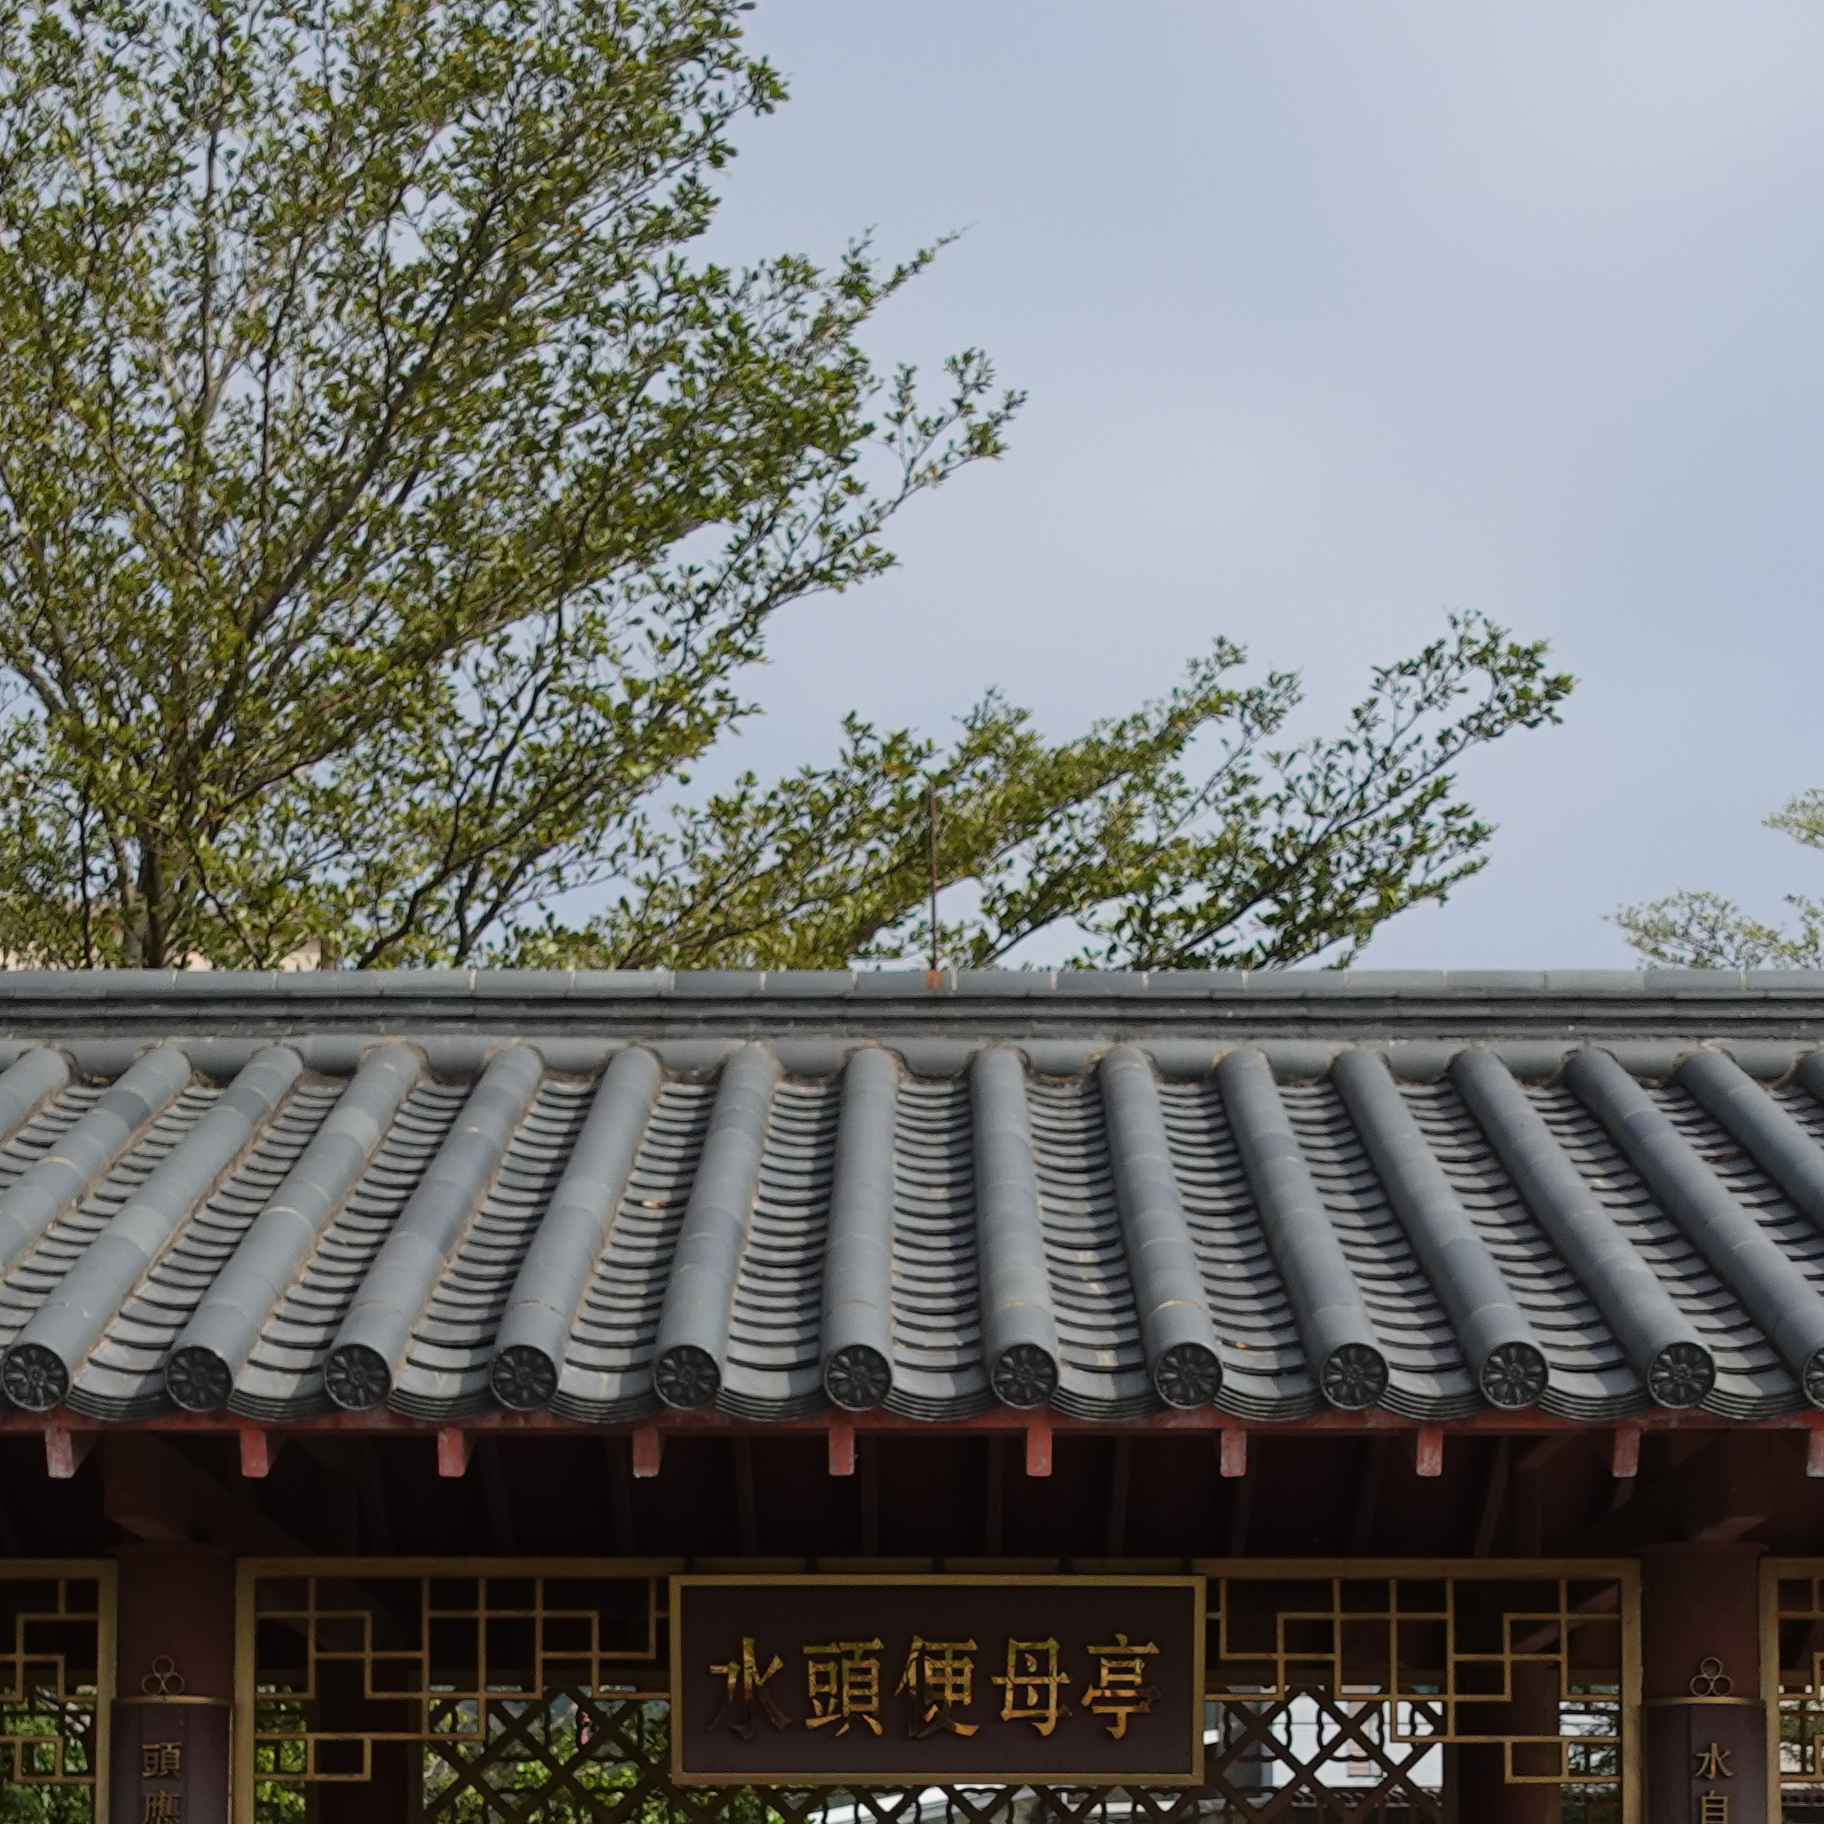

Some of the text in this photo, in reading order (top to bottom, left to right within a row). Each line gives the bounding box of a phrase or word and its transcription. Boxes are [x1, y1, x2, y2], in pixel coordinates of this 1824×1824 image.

[708, 1632, 1162, 1740] 水頭便母亭
